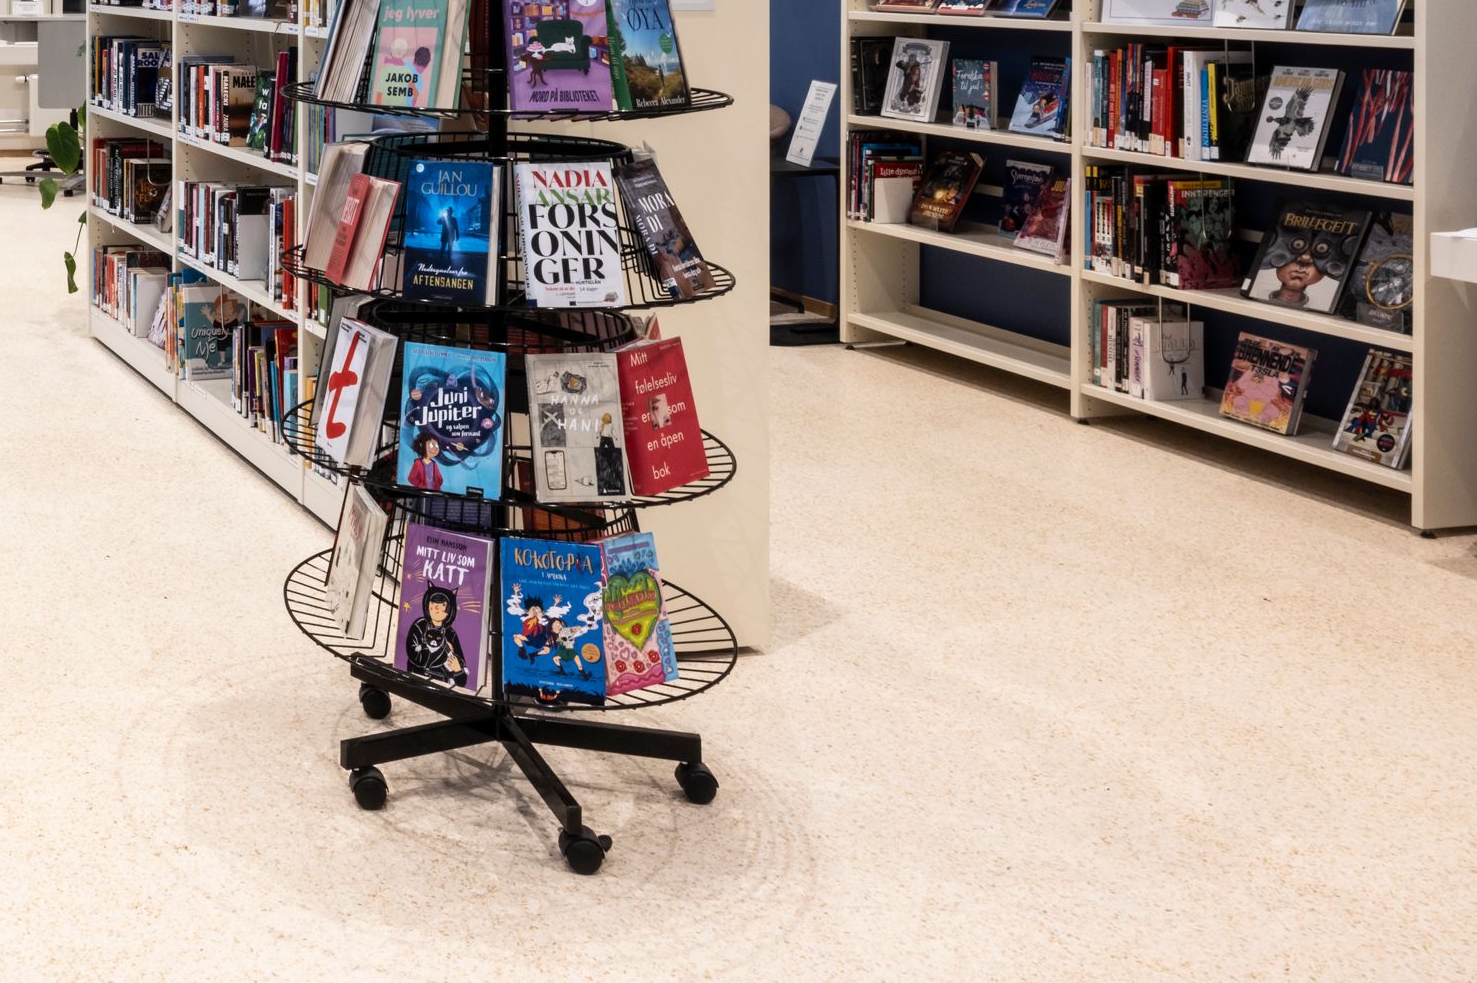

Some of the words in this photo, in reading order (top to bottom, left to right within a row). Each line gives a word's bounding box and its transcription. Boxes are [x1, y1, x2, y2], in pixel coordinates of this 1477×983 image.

[383, 6, 403, 22] jeg
[406, 6, 440, 22] lyver
[626, 7, 665, 32] ØYA
[233, 76, 256, 88] MAŁE
[385, 72, 418, 84] JAKOB
[387, 86, 413, 97] SEMB
[529, 90, 549, 103] MORD
[550, 87, 559, 103] PÅ
[560, 90, 600, 103] BIBLIOTEKET
[635, 98, 659, 108] Rebecca
[438, 169, 463, 184] JAN
[531, 169, 607, 189] NADIA
[421, 182, 478, 197] GUILLOU
[535, 187, 613, 207] ANSAR
[1181, 189, 1235, 198] INNTRENGER
[638, 191, 675, 214] MORA
[528, 202, 617, 230] FORS
[646, 214, 663, 233] DI
[1283, 212, 1358, 235] BRILLEGEIT
[531, 230, 619, 257] ONIN
[635, 214, 651, 243] MORA
[648, 243, 658, 256] DI
[533, 257, 606, 285] GER
[413, 274, 474, 290] AFTENSANGEN
[191, 325, 228, 342] Uniquely
[195, 340, 217, 360] Me
[630, 352, 648, 367] Mitt
[635, 372, 677, 395] følelsesliv
[430, 386, 468, 408] Juni
[550, 393, 599, 406] HANNA
[414, 405, 483, 429] Jupiter
[641, 412, 651, 423] er
[667, 401, 686, 415] som
[557, 418, 598, 432] HANI
[646, 440, 659, 451] en
[660, 431, 684, 449] åpen
[652, 461, 671, 480] bok
[416, 545, 440, 560] MITT
[441, 551, 457, 563] LIV
[457, 554, 476, 568] SOM
[422, 559, 470, 586] KATT
